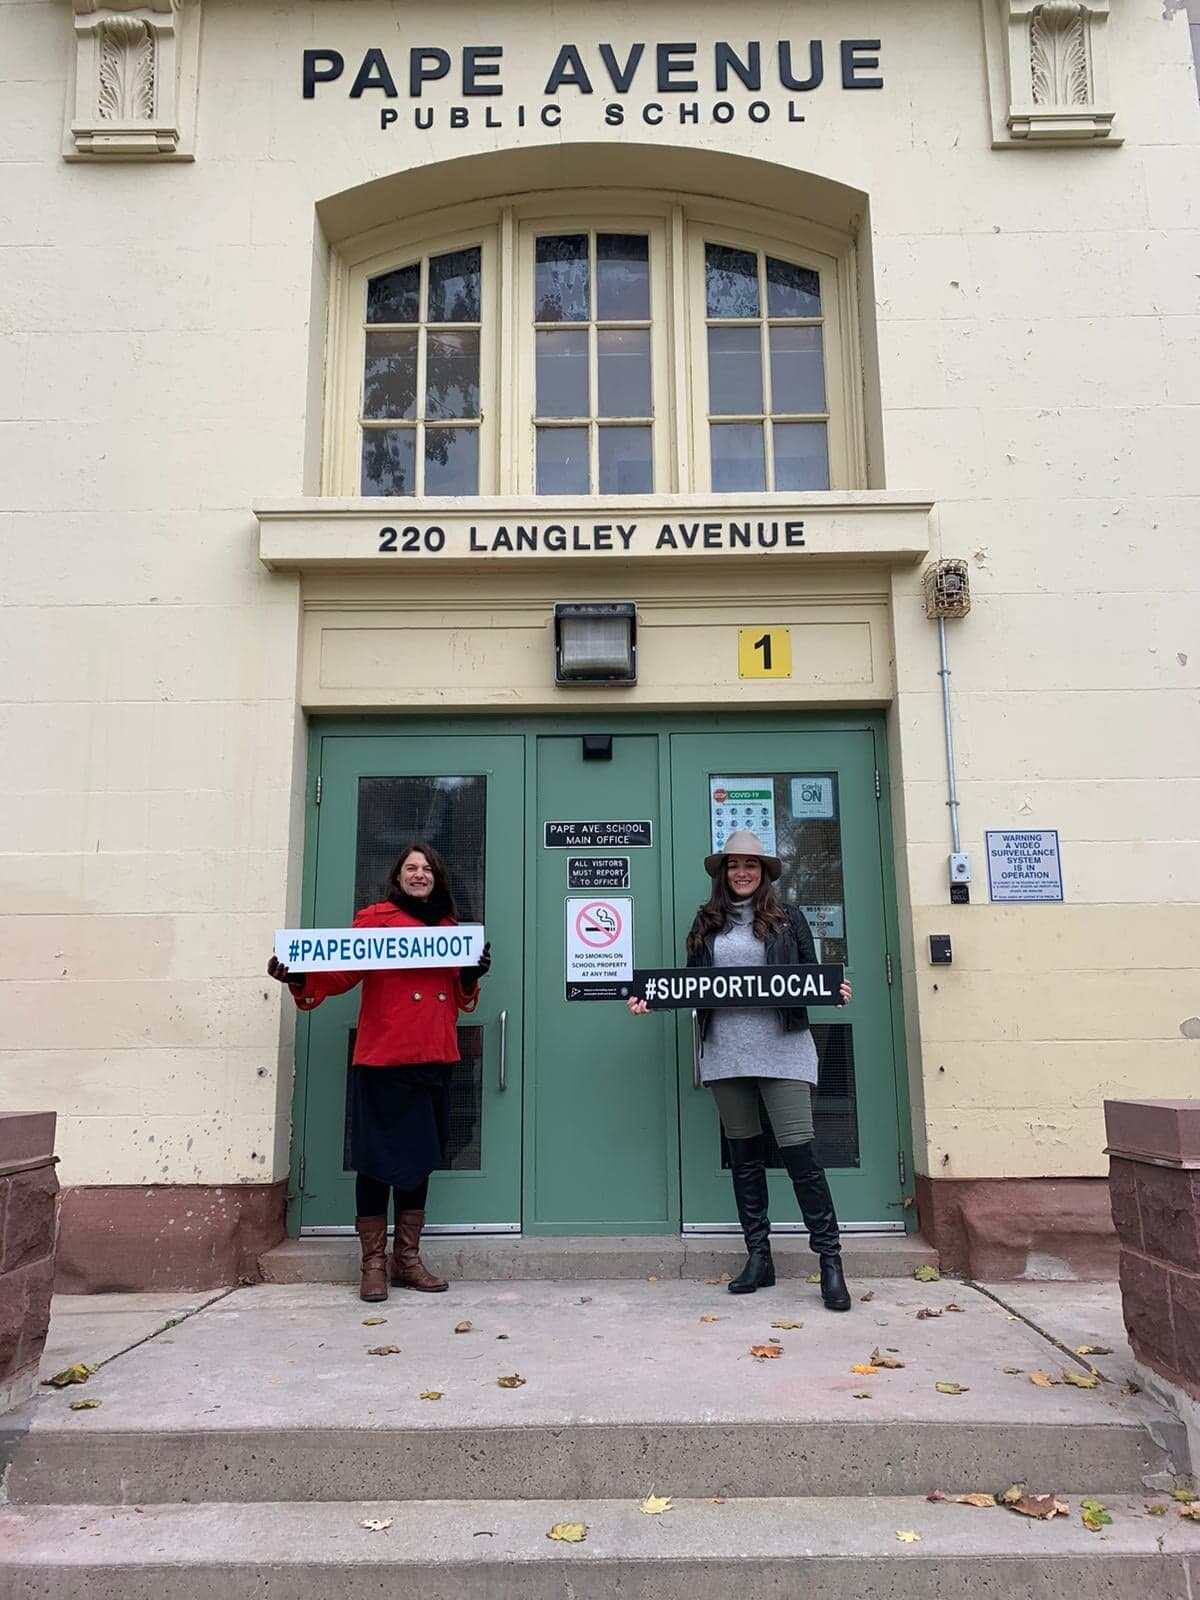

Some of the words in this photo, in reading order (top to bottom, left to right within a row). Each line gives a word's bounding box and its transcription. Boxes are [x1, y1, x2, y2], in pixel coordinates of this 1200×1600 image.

[303, 46, 503, 98] PAPE
[544, 39, 883, 94] AVENUE
[380, 104, 562, 130] PUBLIC
[605, 100, 805, 126] SCHOOL
[379, 526, 446, 552] 220
[469, 525, 637, 551] LANGLEY
[655, 521, 806, 549] AVENUE
[753, 634, 773, 670] 1
[801, 790, 821, 802] ON
[550, 824, 575, 833] PAPE
[606, 823, 645, 833] SCHOOL
[566, 836, 591, 845] MAIN
[596, 835, 630, 844] OFFICE
[1002, 834, 1042, 842] WARNING
[992, 849, 1056, 857] SURVEILLANCE
[1007, 856, 1041, 864] SYSTEM
[1001, 871, 1049, 879] OPERATION
[580, 878, 590, 886] TO
[594, 878, 618, 886] OFFICE
[289, 936, 473, 962] #PAPEGIVESAHOOT
[645, 974, 832, 1000] #SUPPORTLOCAL
